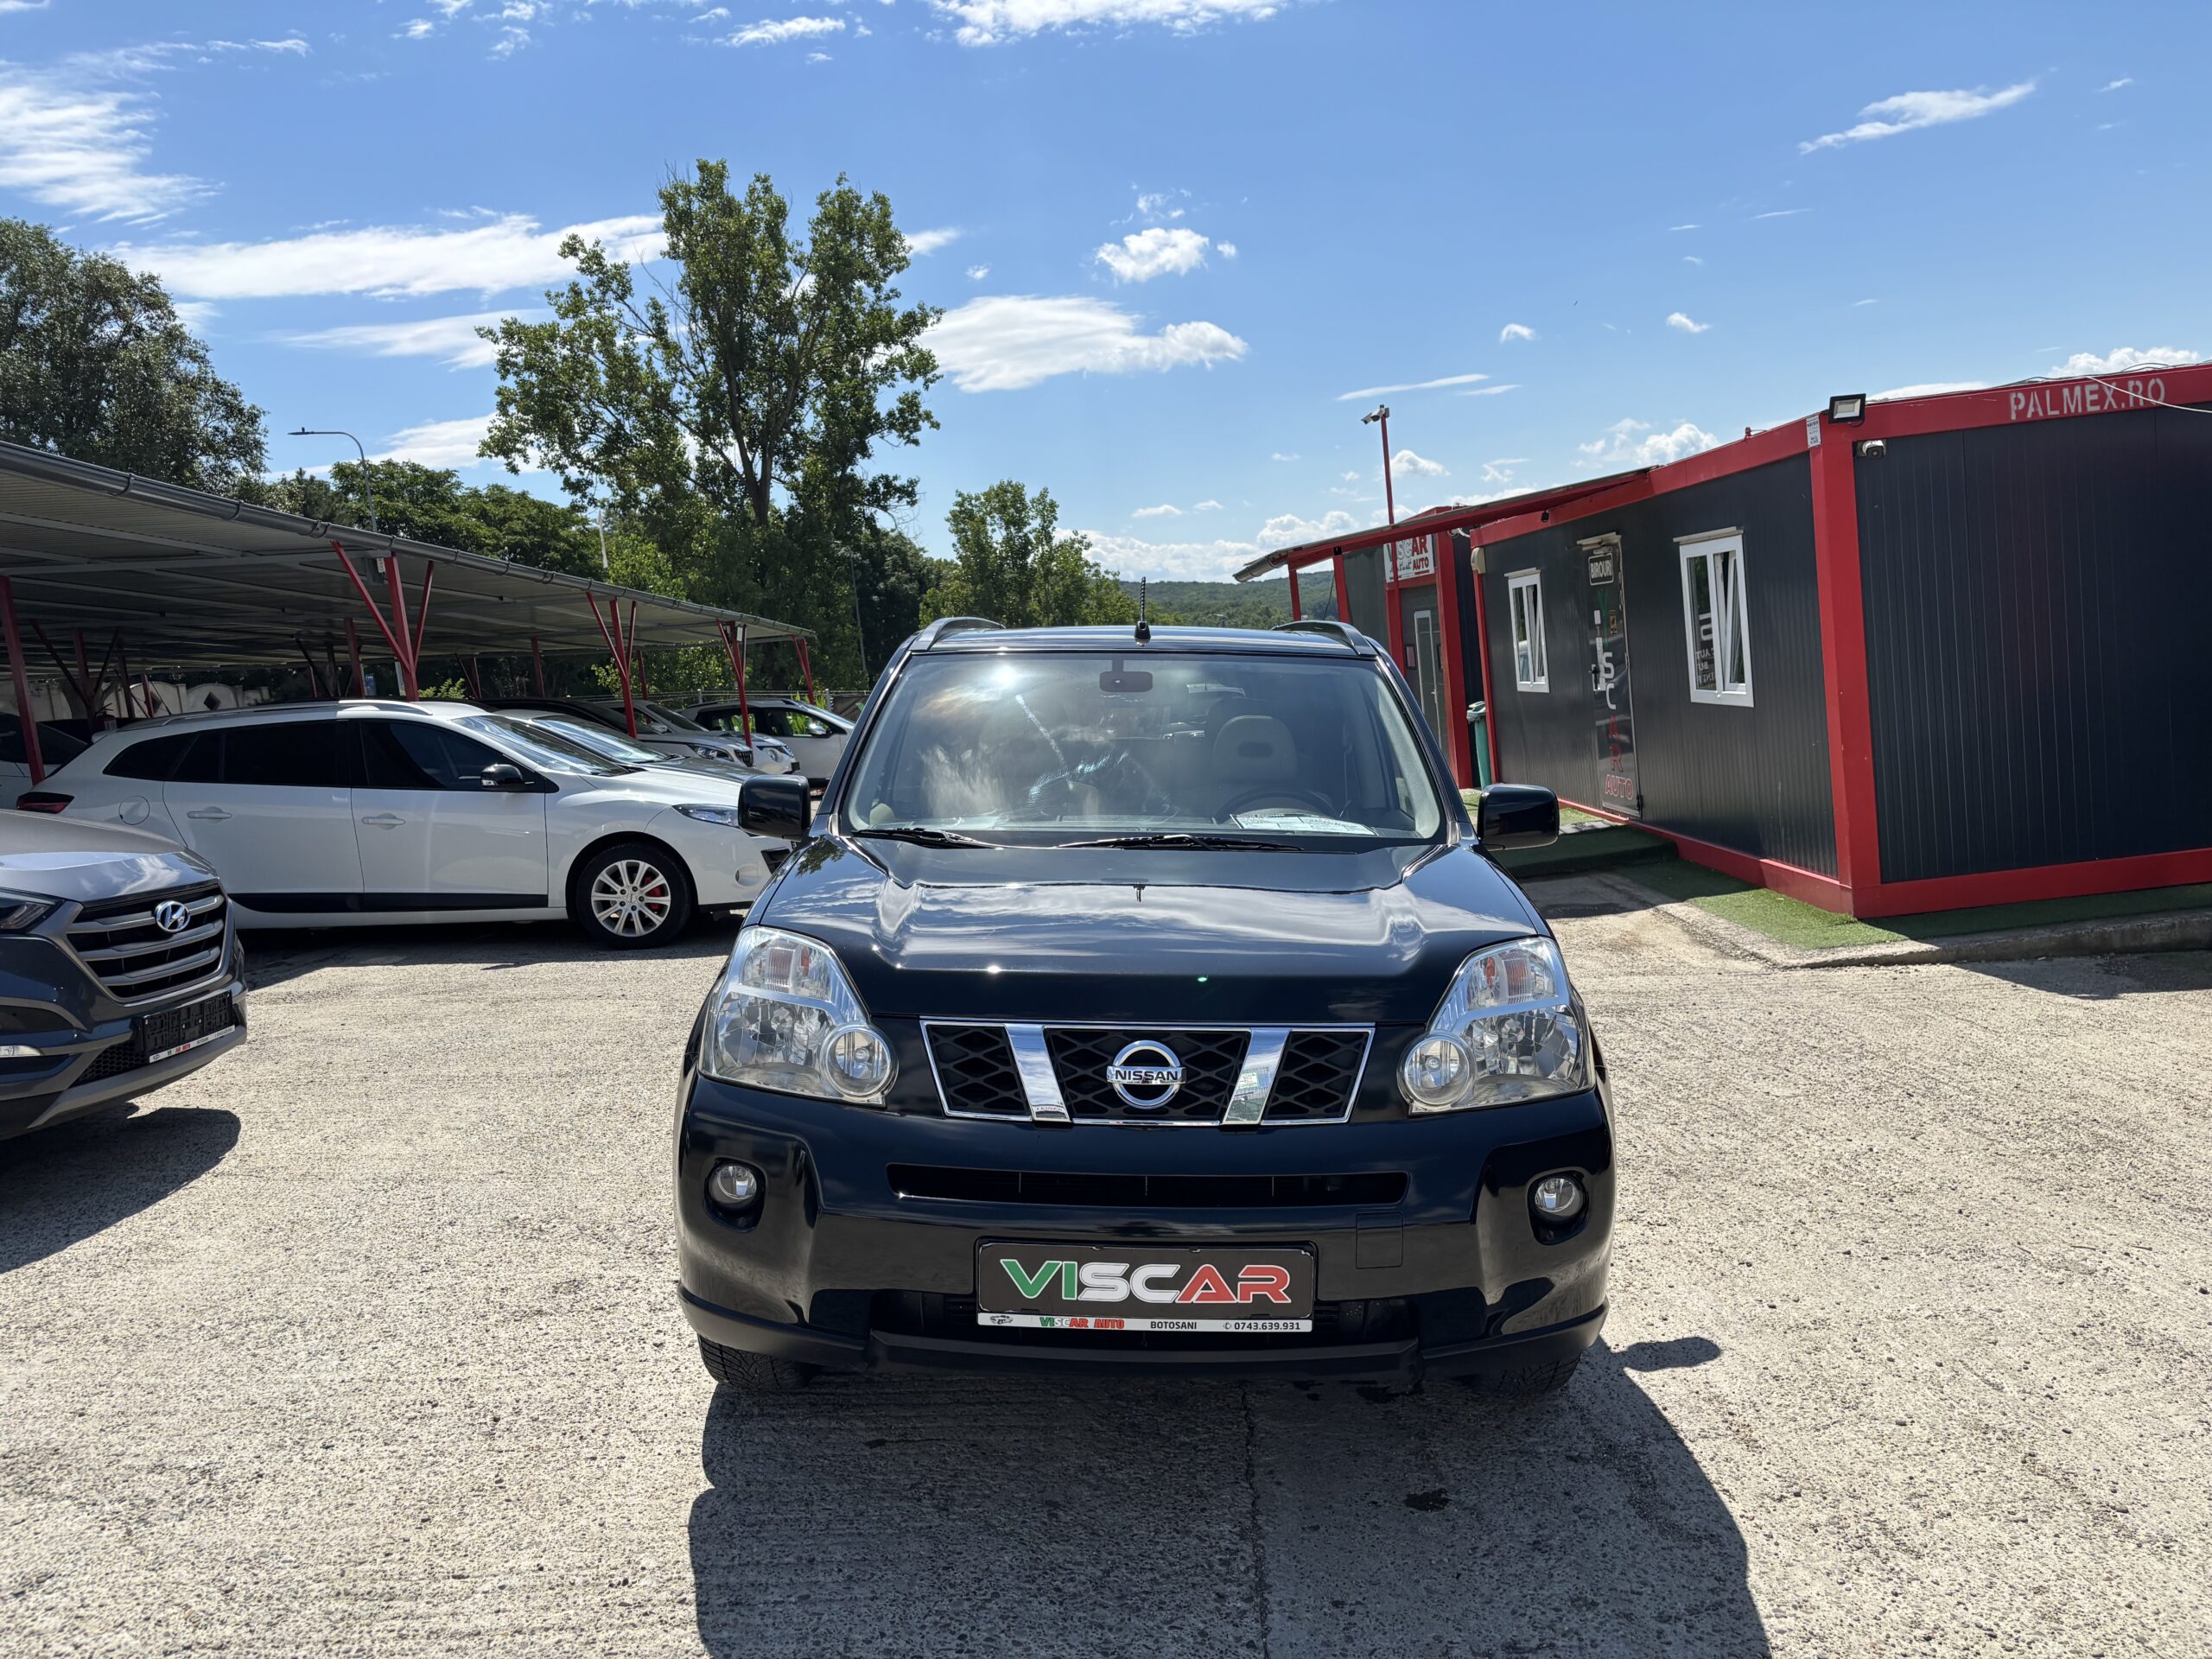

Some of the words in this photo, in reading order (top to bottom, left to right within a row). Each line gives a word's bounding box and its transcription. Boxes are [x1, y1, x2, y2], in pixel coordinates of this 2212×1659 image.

[2010, 378, 2165, 421] PALMEX.RO
[1413, 556, 1429, 571] AUTO
[1605, 774, 1634, 801] AUTO
[1115, 1070, 1178, 1081] NISSAN
[1000, 1258, 1292, 1304] VISCAR
[1039, 1317, 1089, 1328] VISCAR
[1094, 1319, 1125, 1329] AUTO
[1150, 1321, 1197, 1331] BOTOSANI
[1234, 1322, 1300, 1331] 0743.639.931
